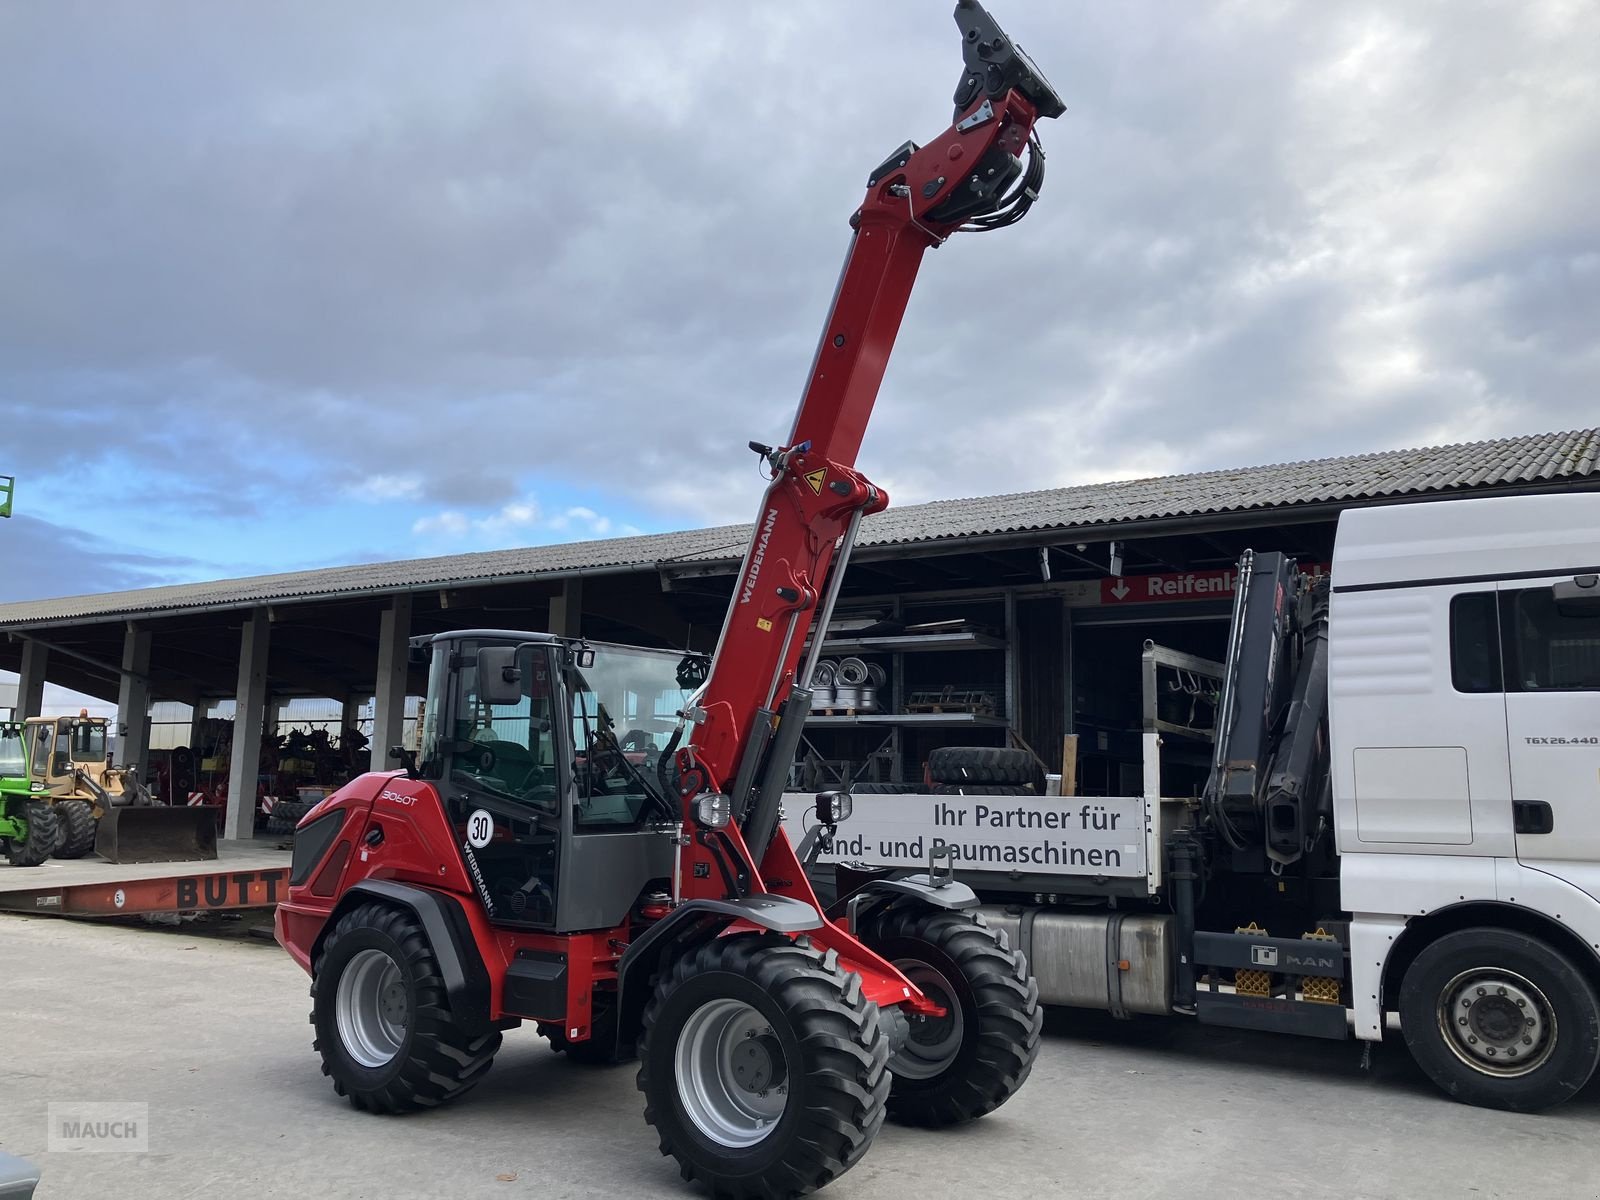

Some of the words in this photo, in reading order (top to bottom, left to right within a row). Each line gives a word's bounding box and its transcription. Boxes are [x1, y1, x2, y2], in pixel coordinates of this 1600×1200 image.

[740, 508, 779, 604] WEIDEMANN
[1148, 572, 1238, 596] Reifenla
[1524, 737, 1549, 745] TGX
[1550, 737, 1599, 745] 26.440
[381, 790, 418, 807] 3060T
[472, 816, 488, 841] 30
[934, 804, 967, 826] Ihr
[976, 805, 1070, 830] Partner
[1080, 806, 1121, 830] für
[819, 834, 872, 856] and-
[879, 836, 923, 859] und
[932, 838, 1121, 867] Baumaschinen
[463, 840, 494, 910] WEIDEMANN
[177, 871, 283, 909] BUTT
[1286, 955, 1334, 968] MAN
